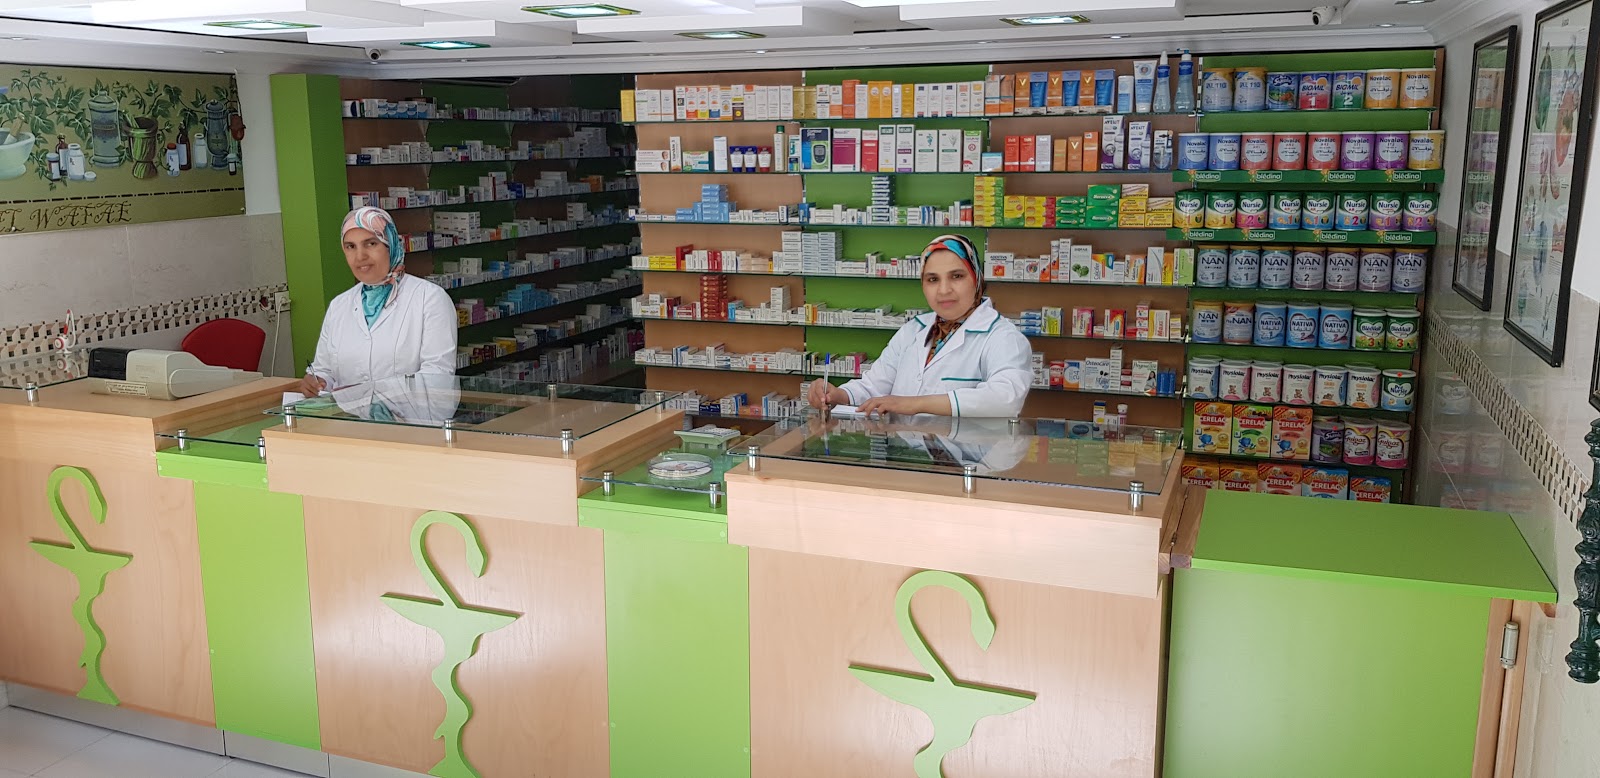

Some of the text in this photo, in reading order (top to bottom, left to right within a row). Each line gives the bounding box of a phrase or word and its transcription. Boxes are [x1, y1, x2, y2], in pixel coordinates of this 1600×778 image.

[1308, 96, 1315, 107] 1
[1344, 96, 1353, 105] 2
[30, 201, 131, 230] WAFAE
[1221, 215, 1226, 224] 1
[1247, 216, 1254, 224] 2
[1288, 215, 1293, 224] 1
[1314, 216, 1319, 224] 1
[1352, 216, 1358, 225] 2
[1385, 217, 1391, 226] 1
[1416, 217, 1422, 226] 2
[1297, 258, 1320, 266] NAN
[1397, 258, 1422, 267] NAN
[1368, 338, 1374, 346] 3
[1397, 339, 1404, 347] 3
[1265, 478, 1295, 486] CERELAC
[1310, 482, 1340, 490] CERELAC
[1355, 491, 1384, 500] CERELAC
